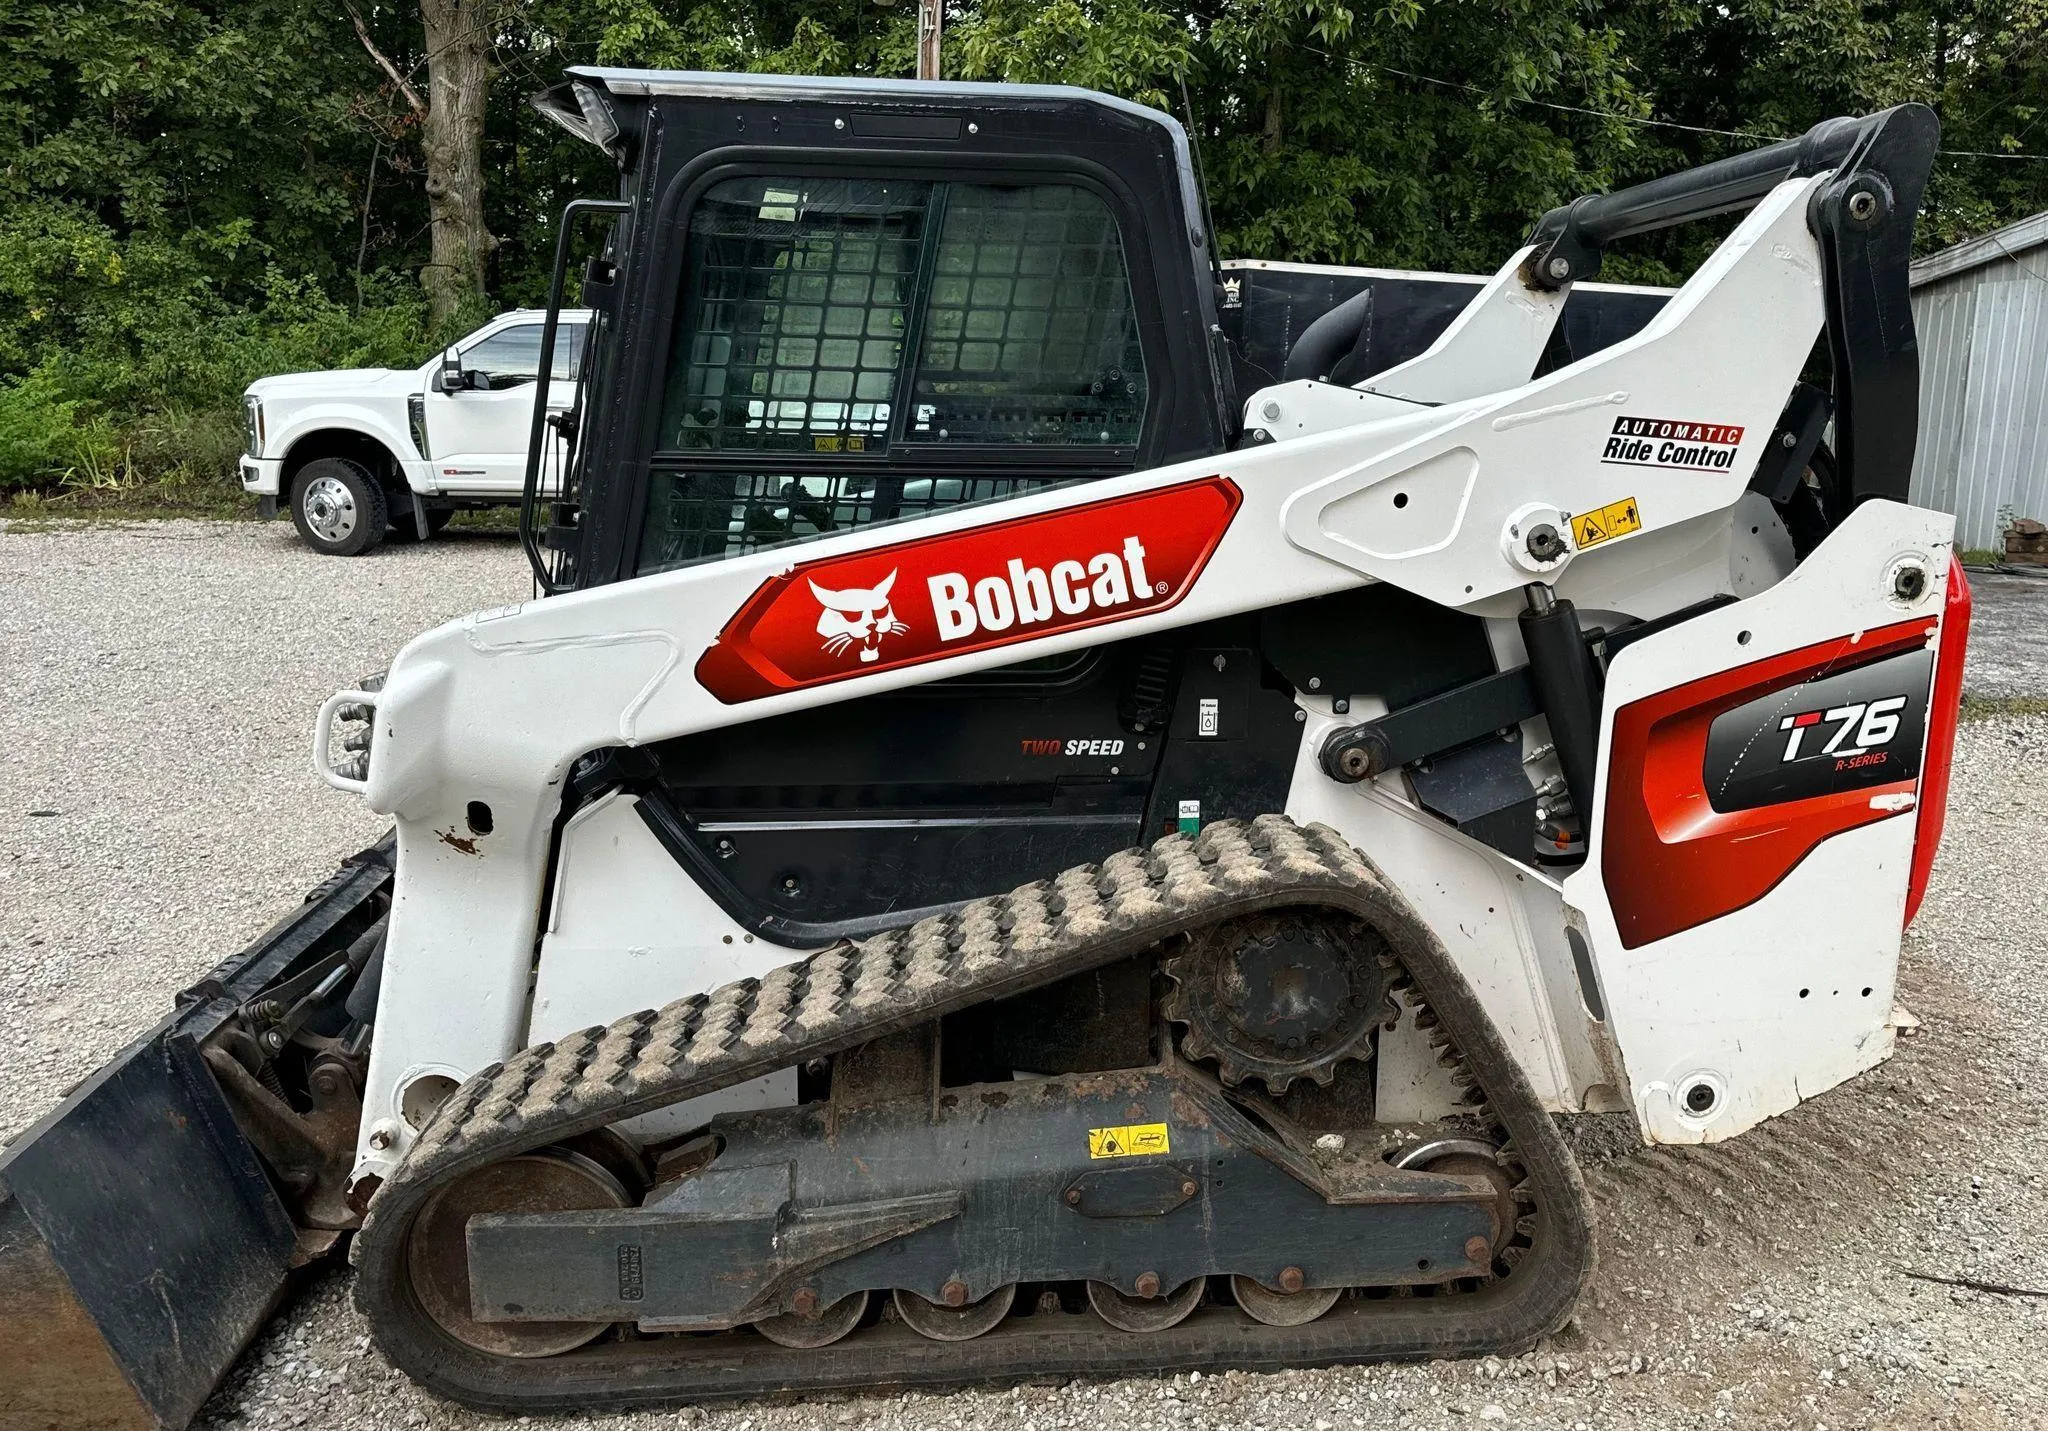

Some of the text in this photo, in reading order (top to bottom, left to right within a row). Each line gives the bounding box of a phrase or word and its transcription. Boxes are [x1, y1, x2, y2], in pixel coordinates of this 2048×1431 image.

[1617, 419, 1739, 443] AUTOMATIC
[1602, 437, 1738, 468] Ride Control
[927, 536, 1154, 641] Bobcat
[1778, 695, 1907, 762] T76
[1021, 739, 1124, 755] TWO SPEED
[1835, 752, 1888, 771] R-SERIES
